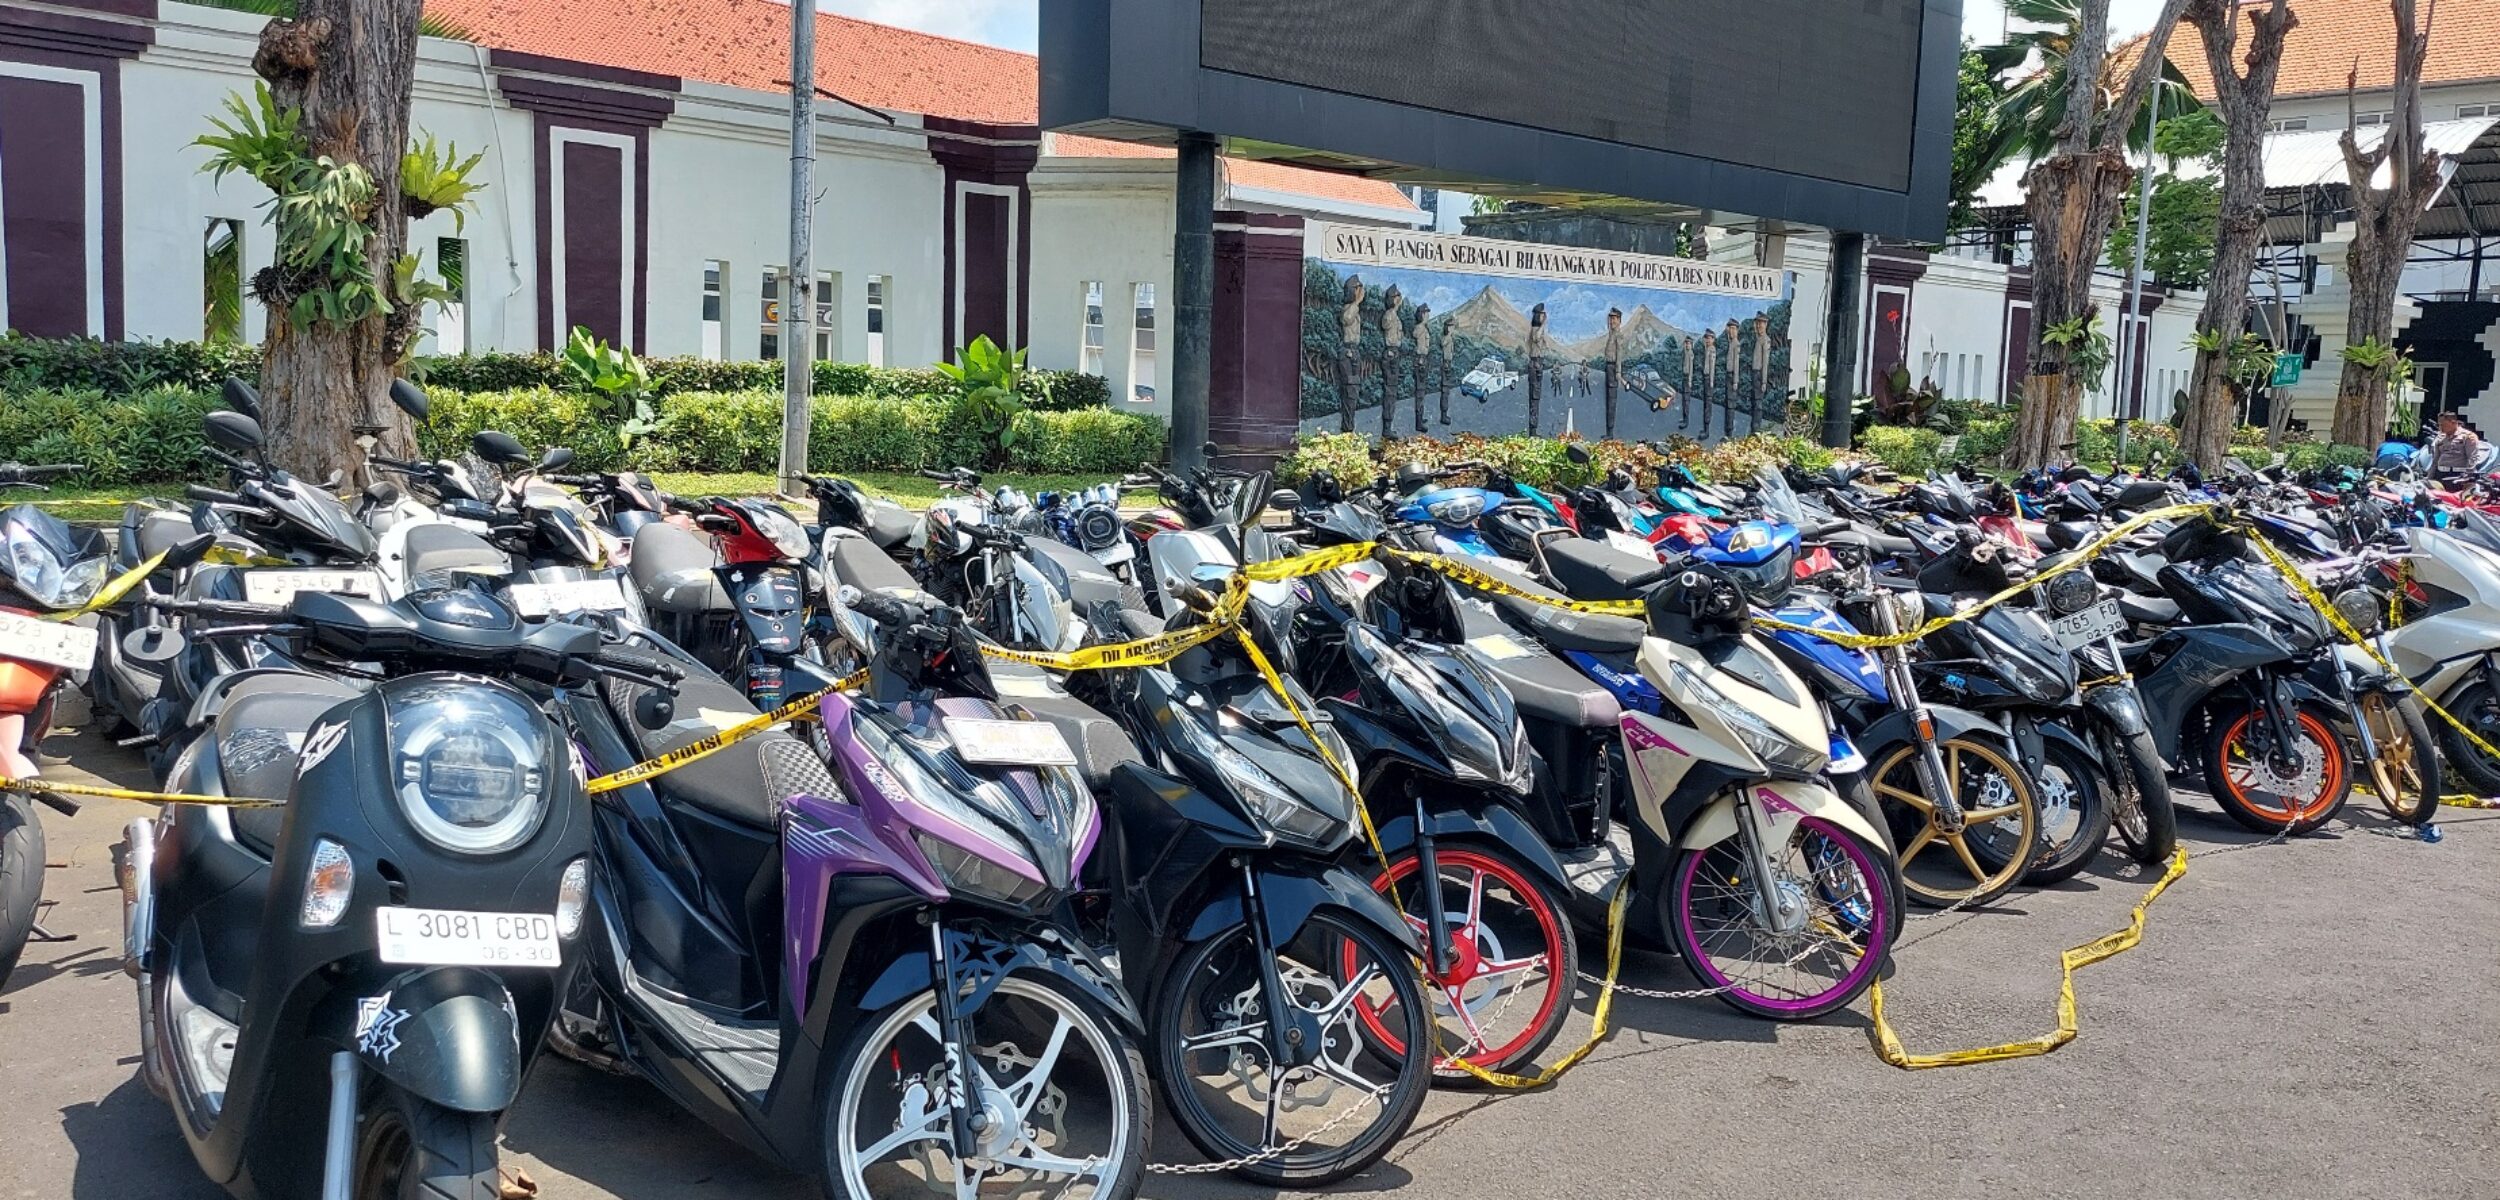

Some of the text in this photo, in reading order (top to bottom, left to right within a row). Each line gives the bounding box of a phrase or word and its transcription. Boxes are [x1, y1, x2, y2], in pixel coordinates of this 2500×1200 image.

[1336, 233, 1774, 292] SAYA BANGGA SEBAGAI BHAYANGKARA POLRESTABES SURABAYA
[387, 911, 550, 941] L 3081 CBD
